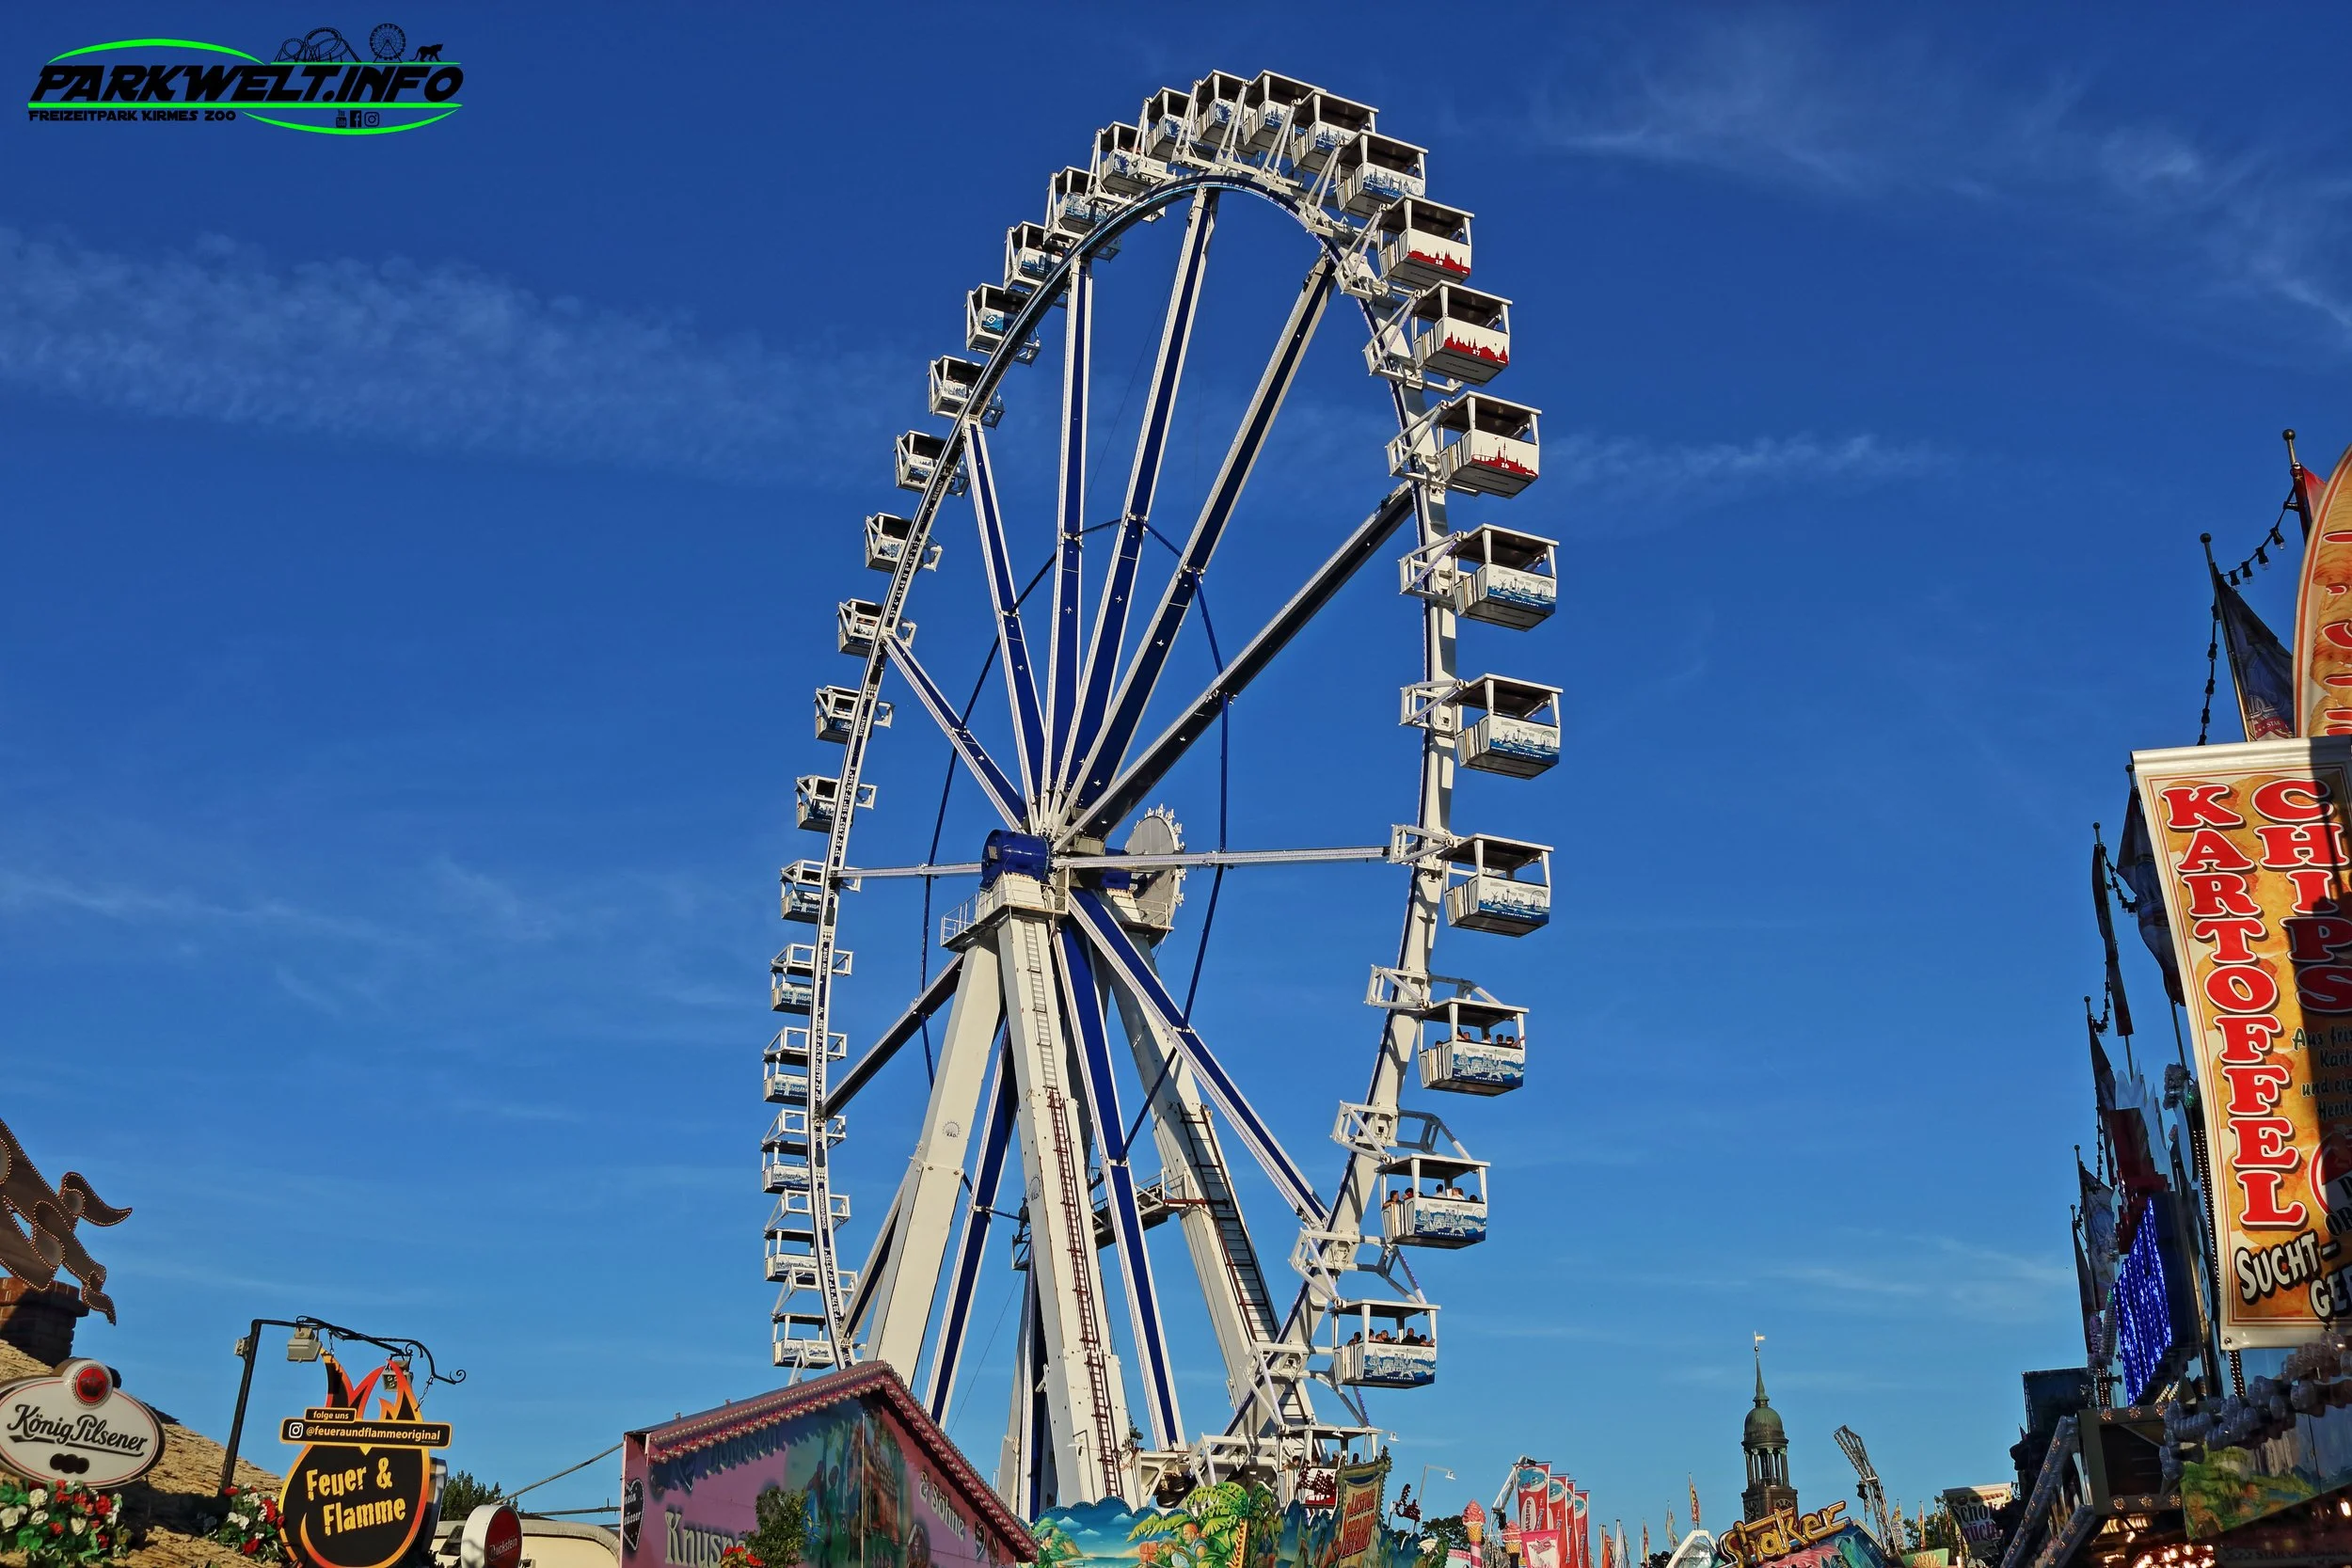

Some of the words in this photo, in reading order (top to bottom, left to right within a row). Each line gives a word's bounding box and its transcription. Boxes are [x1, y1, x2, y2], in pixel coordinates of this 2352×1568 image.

[859, 714, 867, 736] SYDNEY
[2250, 778, 2352, 1014] CHIPS
[2158, 783, 2308, 1227] KARTOFFEL
[2291, 1027, 2324, 1051] Aus
[2319, 1048, 2352, 1069] Kart
[2301, 1076, 2329, 1097] und
[2316, 1099, 2352, 1121] Herst
[2235, 1230, 2341, 1304] SUCHT-
[8, 1403, 74, 1444] König
[71, 1414, 148, 1452] Pilsener
[306, 1425, 440, 1442] @feueraundflammeoriginal
[312, 1411, 334, 1420] folge
[306, 1466, 367, 1502] Feuer
[376, 1457, 393, 1490] &
[323, 1497, 406, 1536] Flamme
[931, 1482, 964, 1542] Söhne
[1719, 1500, 1847, 1568] Shaker
